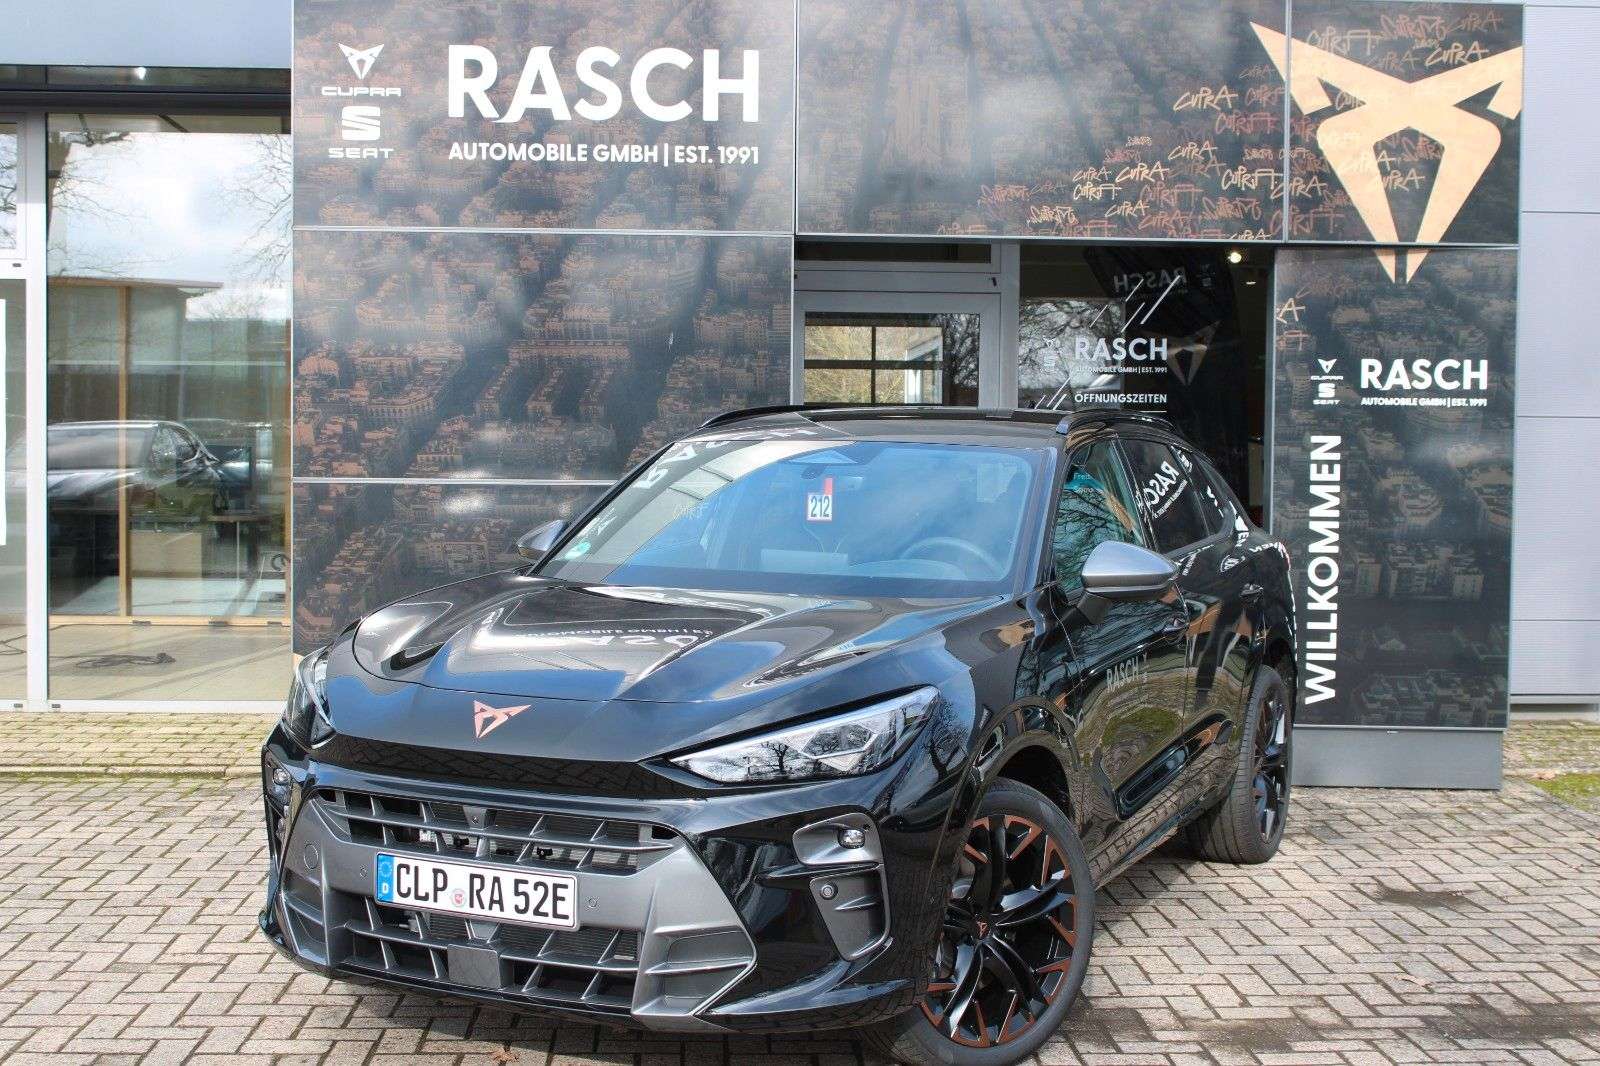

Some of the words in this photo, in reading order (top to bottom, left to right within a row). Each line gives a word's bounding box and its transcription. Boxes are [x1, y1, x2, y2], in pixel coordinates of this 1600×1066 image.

[1424, 40, 1489, 67] CUPRA
[321, 87, 401, 96] CUPRA
[449, 44, 759, 122] RASCH
[1173, 84, 1238, 111] CUPRA
[328, 148, 394, 158] SEAT
[449, 142, 588, 162] AUTOMOBILE
[593, 144, 658, 163] GMBH
[674, 146, 712, 163] EST.
[718, 146, 760, 164] 1991
[1168, 140, 1218, 160] CUPRA
[1115, 161, 1170, 183] CUPRA
[1382, 168, 1425, 192] UPRA
[1104, 199, 1149, 218] CUPRA
[1075, 336, 1168, 361] RASCH
[1360, 358, 1488, 390] RASCH
[1074, 391, 1168, 404] ÖFFNUNGSZEITEN
[1360, 397, 1418, 406] AUTOMOBILE
[810, 495, 830, 518] 212
[1305, 435, 1342, 705] WILLKOMMEN
[396, 863, 449, 903] CLP
[468, 873, 505, 913] RA
[513, 878, 570, 920] 52E
